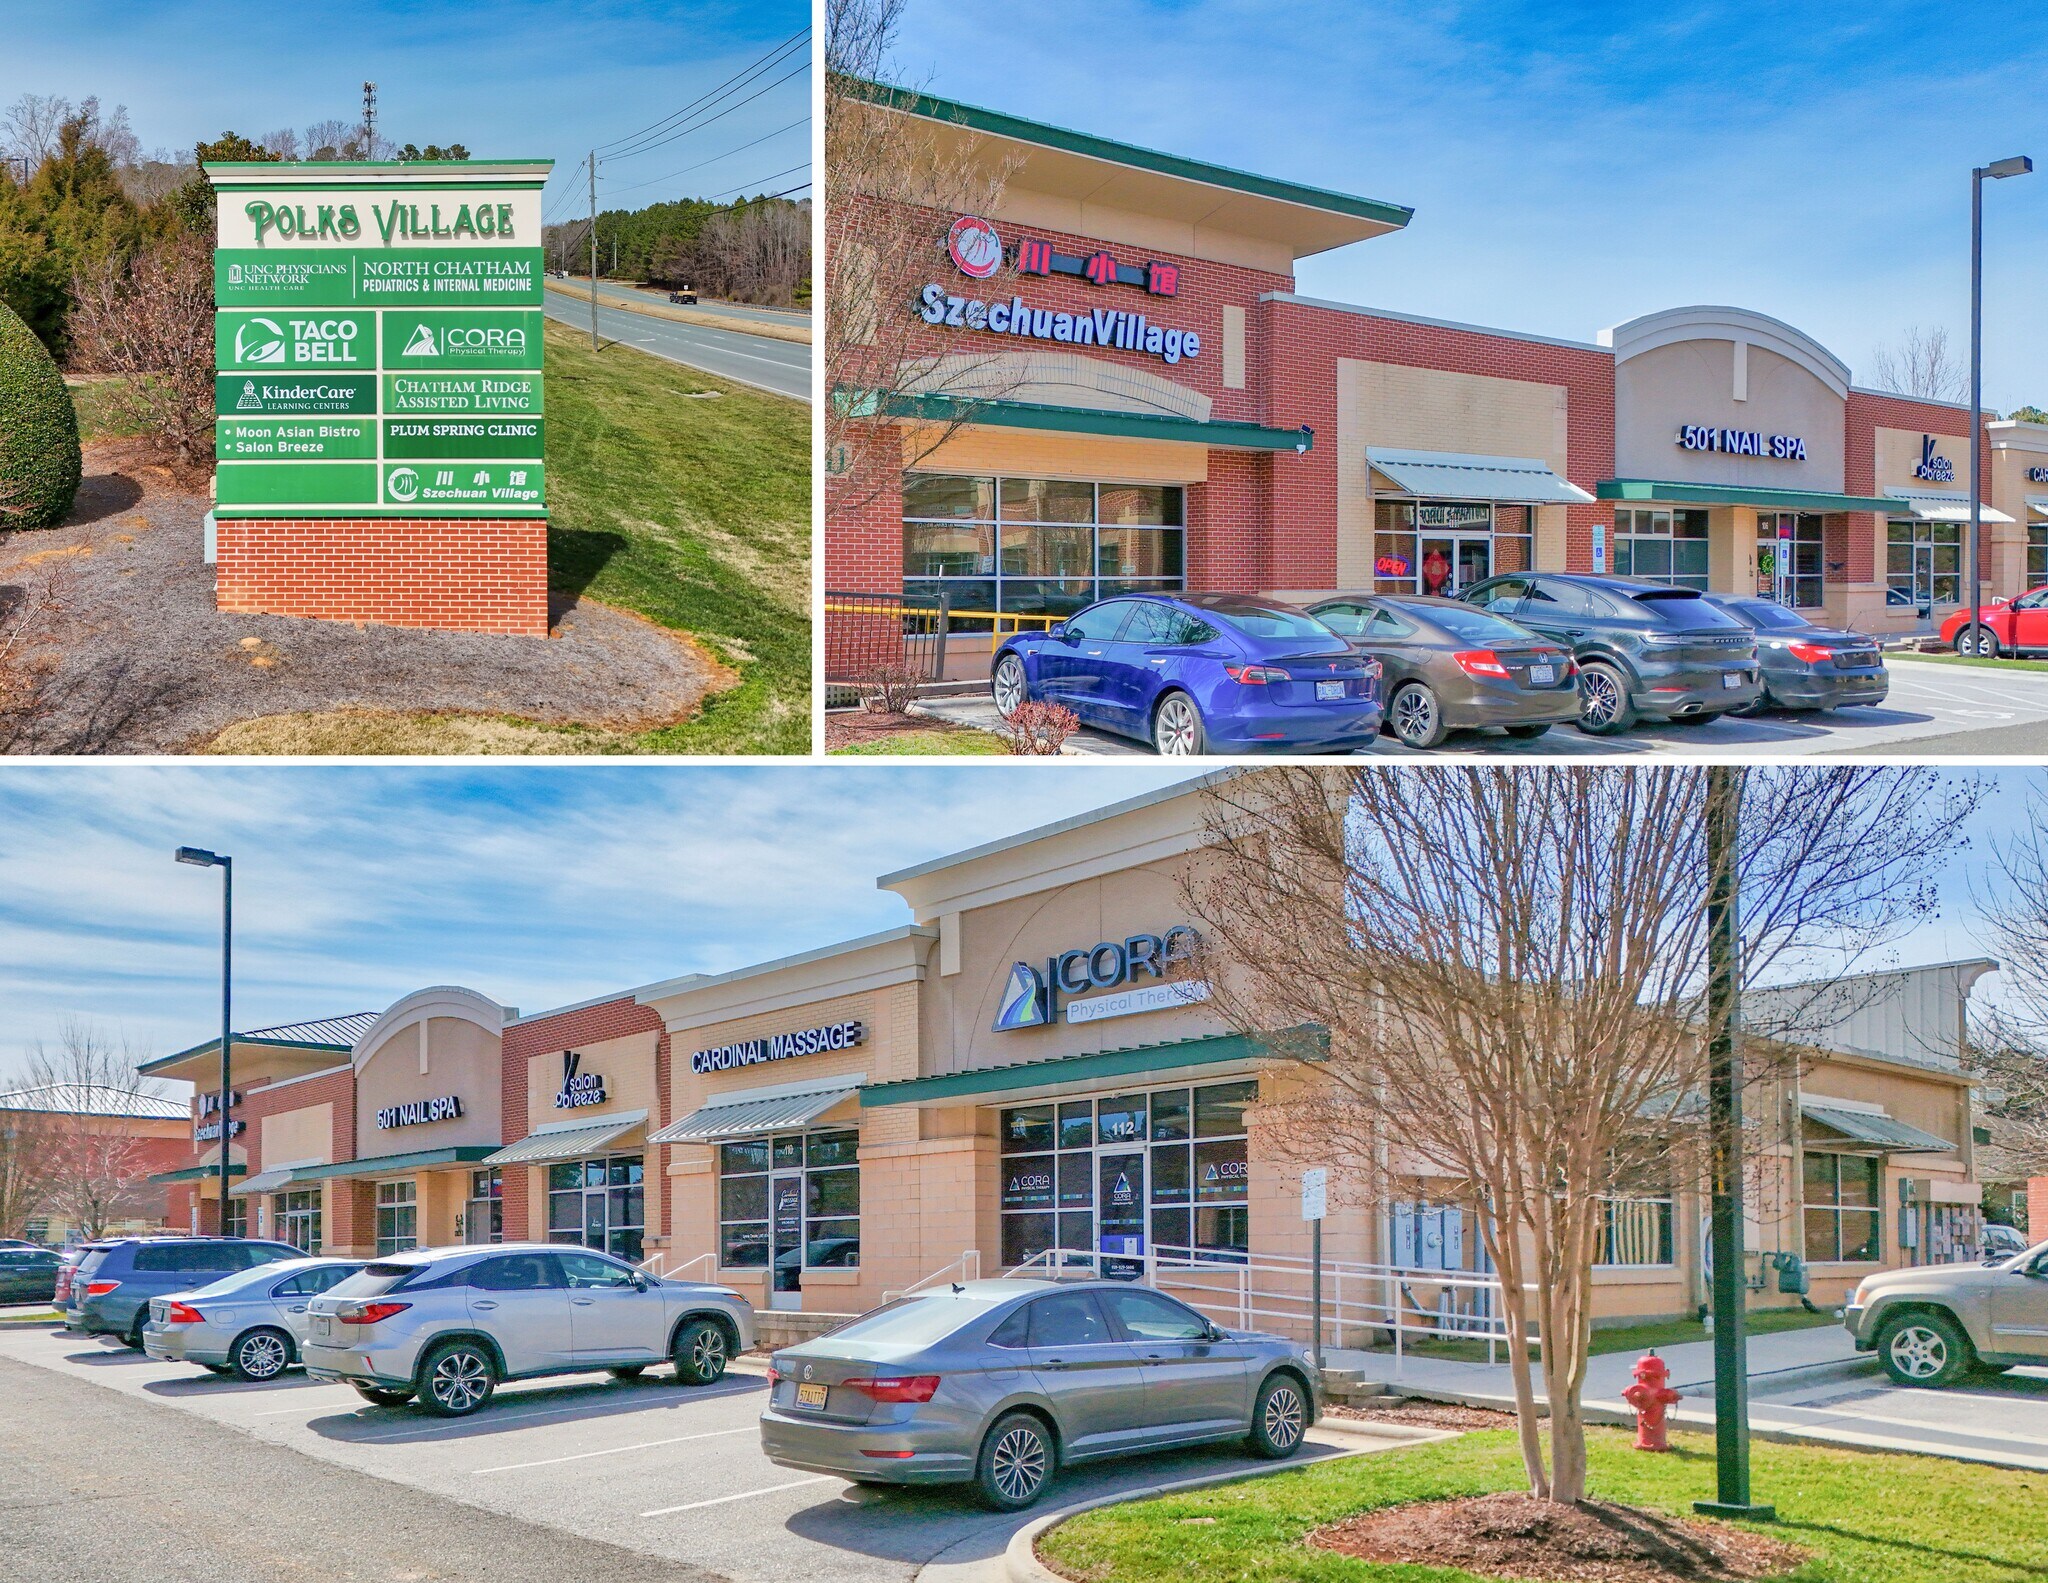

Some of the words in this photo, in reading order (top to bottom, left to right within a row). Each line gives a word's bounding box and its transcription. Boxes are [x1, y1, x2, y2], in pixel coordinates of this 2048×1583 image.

[245, 200, 361, 242] POLKS
[372, 200, 514, 241] VILLAGE
[245, 264, 274, 274] UNC
[277, 263, 347, 274] PHYSICIANS
[363, 262, 430, 276] NORTH
[434, 261, 531, 275] CHATHAM
[244, 274, 310, 284] NETWORK
[363, 279, 419, 292] PEDIATRICS
[422, 279, 430, 292] &
[434, 279, 480, 292] INTERNAL
[483, 278, 532, 291] MEDICINE
[289, 320, 358, 341] TACO
[447, 328, 526, 347] CORA
[295, 342, 357, 362] BELL
[449, 347, 487, 356] Physical
[488, 347, 525, 357] Therapy
[262, 384, 355, 399] KinderCare
[395, 379, 478, 393] CHATHAM
[481, 379, 532, 393] RIDGE
[313, 402, 350, 410] CENTERS
[395, 395, 469, 409] ASSISTED
[474, 394, 530, 409] LIVING
[236, 427, 272, 438] Moon
[276, 427, 314, 438] Asian
[319, 426, 361, 438] Bistro
[390, 425, 430, 437] PLUM
[432, 425, 486, 437] SPRING
[487, 425, 537, 437] CLINIC
[236, 441, 273, 453] Salon
[278, 441, 324, 453] Breeze
[1683, 425, 1718, 452] 501
[1724, 429, 1770, 457] NAIL
[1773, 435, 1808, 461] SPA
[1932, 456, 1953, 470] salon
[422, 488, 487, 499] Szechuan
[491, 488, 538, 500] Village
[1376, 556, 1408, 577] OPEN
[1056, 925, 1203, 996] CORA
[1069, 993, 1132, 1019] Physical
[690, 1038, 768, 1075] CARDINAL
[769, 1020, 856, 1061] MASSAGE
[569, 1072, 598, 1091] salon
[561, 1088, 601, 1109] breeze
[376, 1107, 397, 1130] 501
[399, 1101, 429, 1126] NAIL
[430, 1095, 457, 1121] SPA
[1111, 1121, 1135, 1136] 112
[1020, 1174, 1051, 1187] CORA
